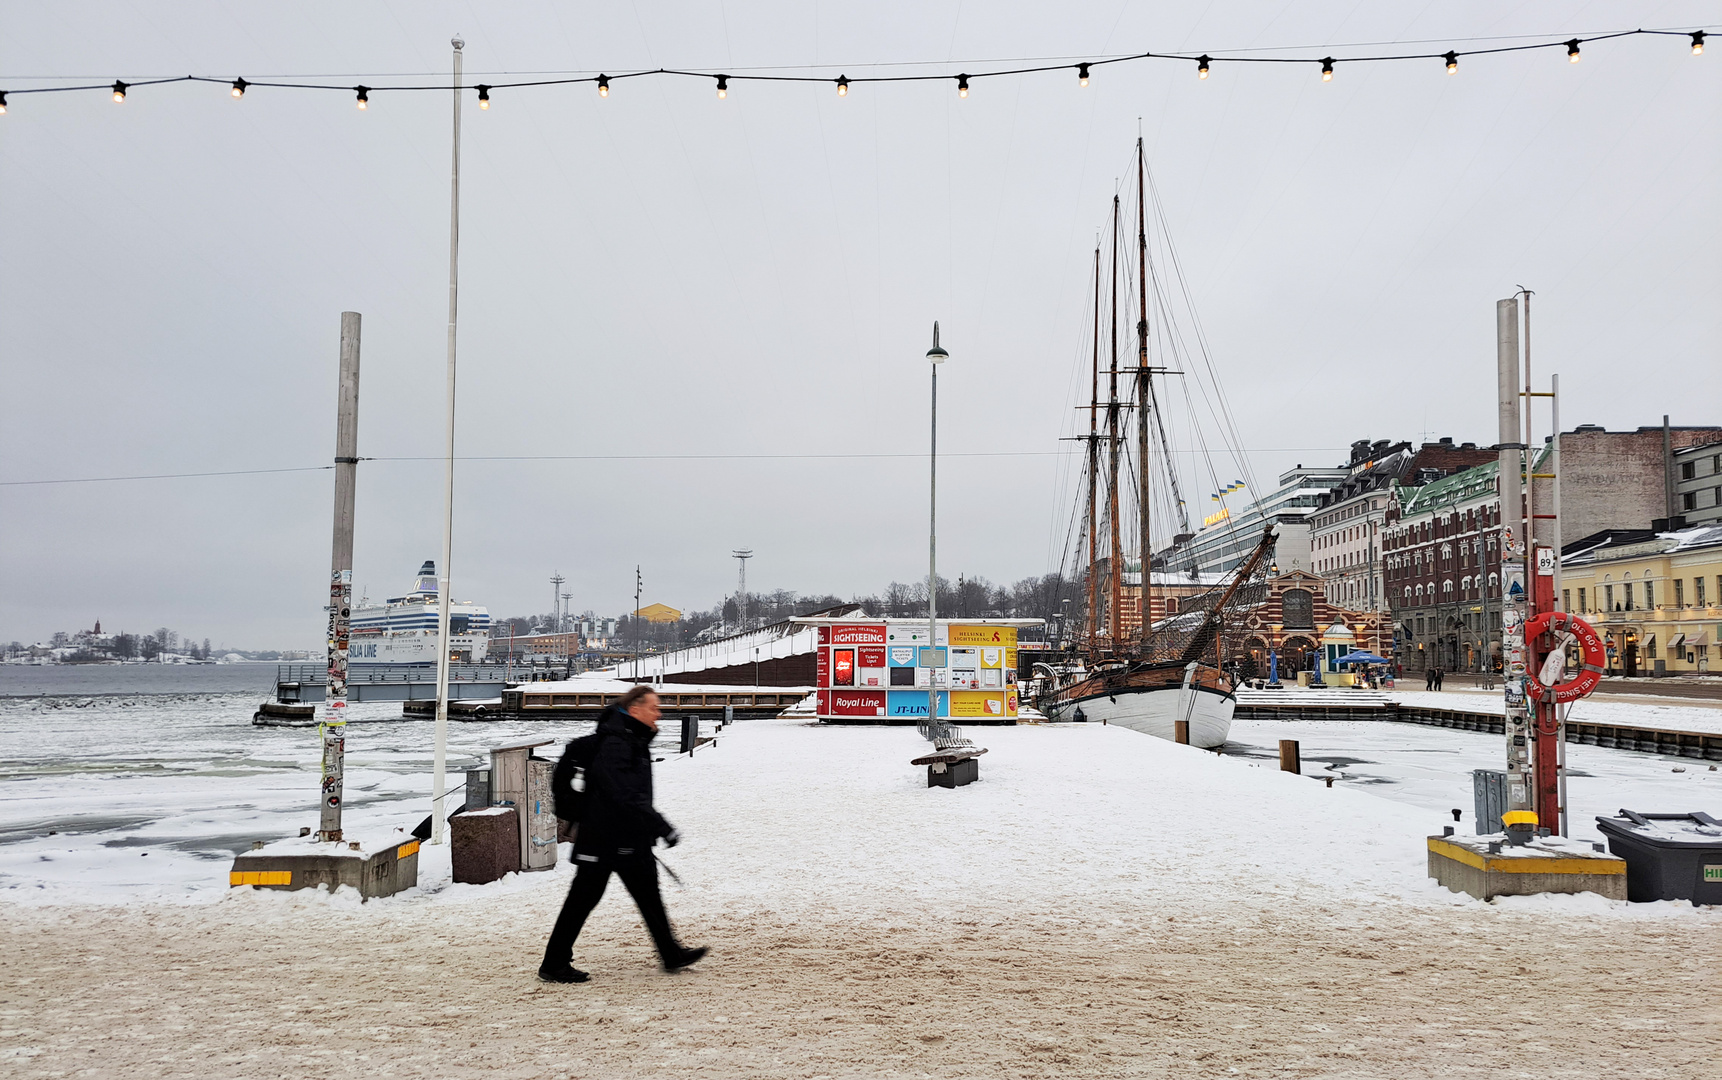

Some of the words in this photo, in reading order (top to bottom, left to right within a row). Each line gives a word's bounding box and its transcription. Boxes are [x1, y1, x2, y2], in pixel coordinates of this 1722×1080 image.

[1544, 550, 1548, 558] 1
[1540, 558, 1551, 567] 89
[834, 633, 884, 643] SIGHTSEEING
[364, 644, 377, 658] LINE
[1557, 676, 1594, 699] HELSINGI
[836, 697, 860, 709] Royal
[860, 697, 880, 707] Line
[894, 705, 930, 714] JT-LIN
